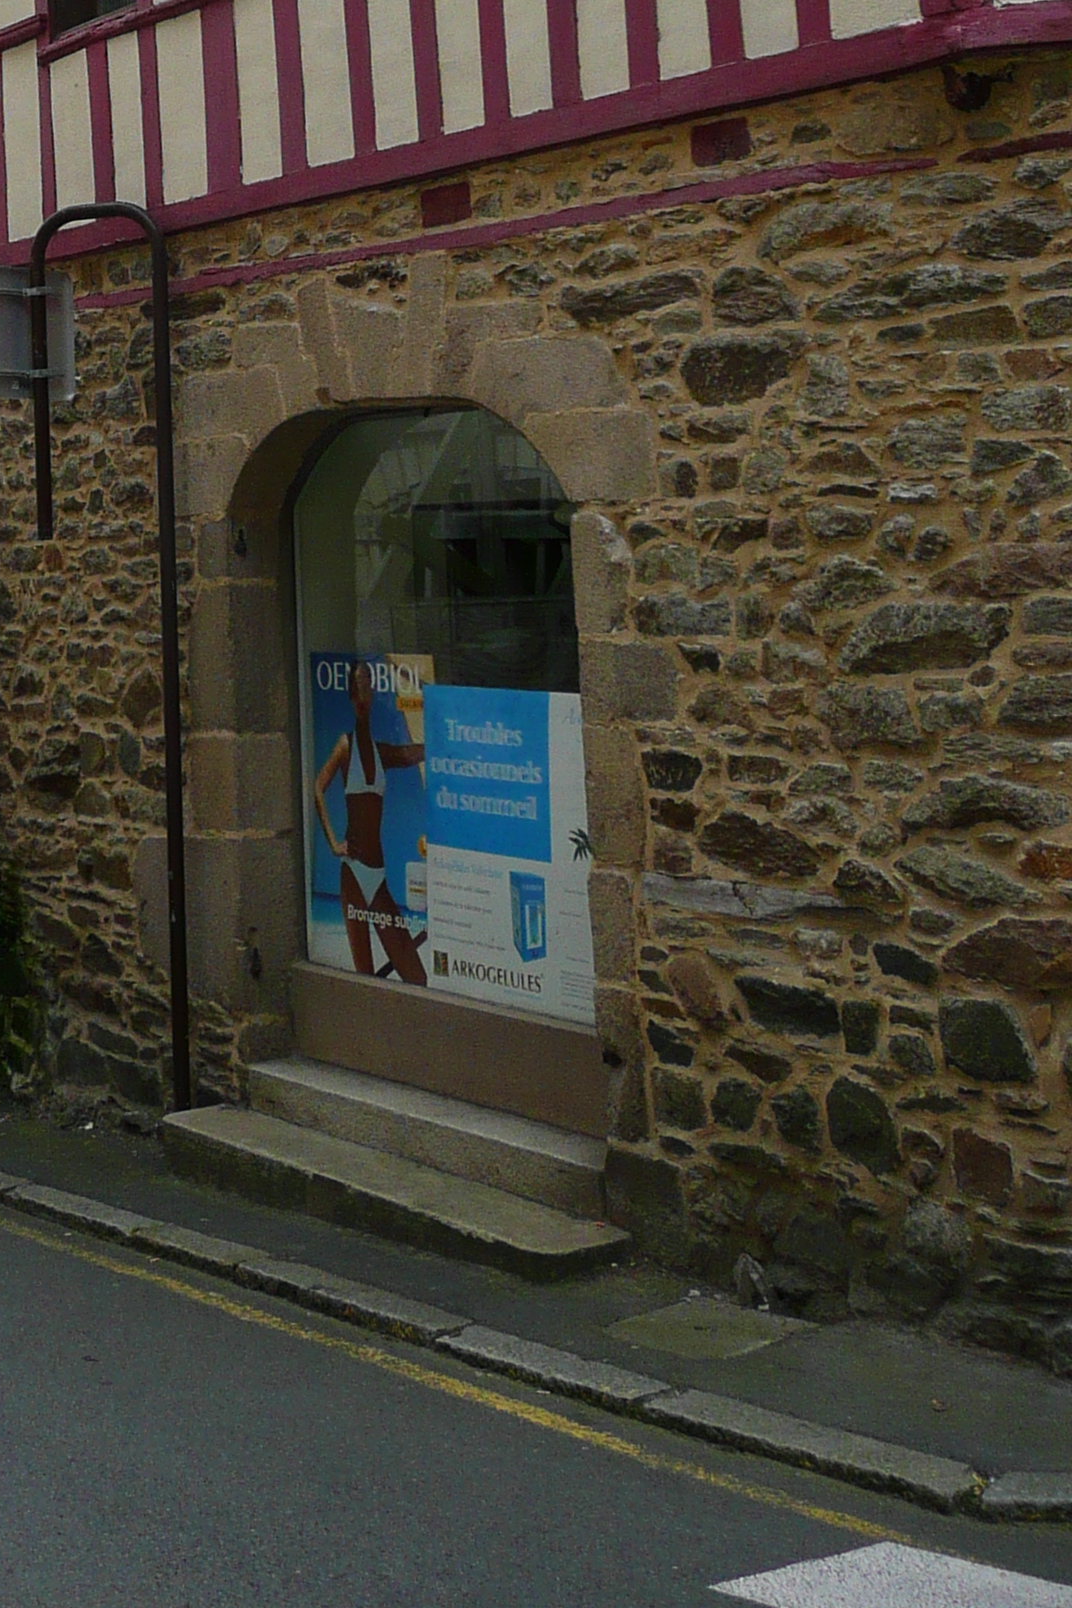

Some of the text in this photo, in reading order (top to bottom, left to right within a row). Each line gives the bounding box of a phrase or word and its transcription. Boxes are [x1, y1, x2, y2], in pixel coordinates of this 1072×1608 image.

[446, 718, 523, 747] Troubles
[430, 754, 543, 784] occasionnels
[436, 785, 538, 820] du sommeil
[347, 904, 392, 929] Bronzage
[452, 959, 542, 993] ARKOGELULES
